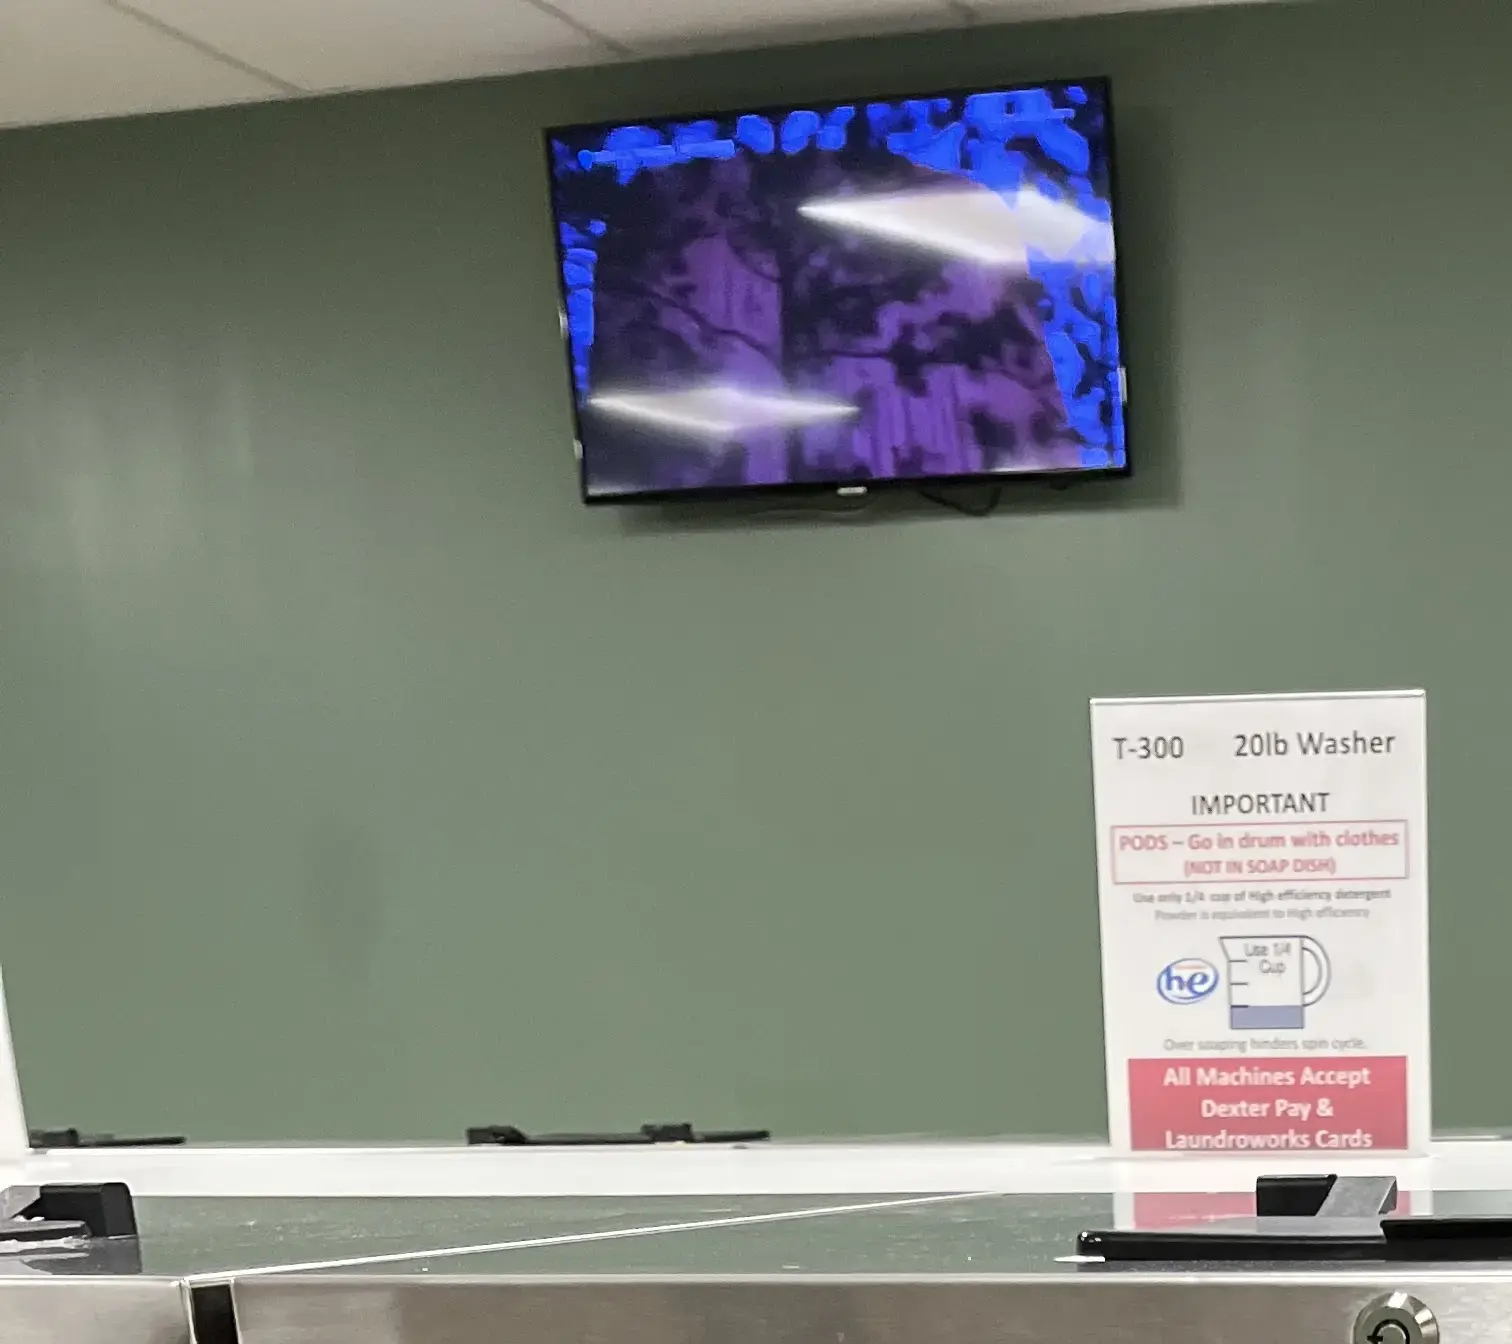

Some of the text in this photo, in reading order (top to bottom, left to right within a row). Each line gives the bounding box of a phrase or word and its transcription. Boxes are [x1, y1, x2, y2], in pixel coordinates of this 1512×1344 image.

[1114, 732, 1395, 760] T-300 20lb Washer
[1191, 793, 1330, 816] IMPORTANT
[1120, 830, 1399, 850] PODS Go in drum with clothes
[1184, 857, 1336, 877] (NOT IN SOAP DISH)
[1163, 1067, 1370, 1090] All Machines Accept
[1201, 1099, 1333, 1120] Dexter Pay &
[1165, 1131, 1372, 1149] Laundroworks Cards
